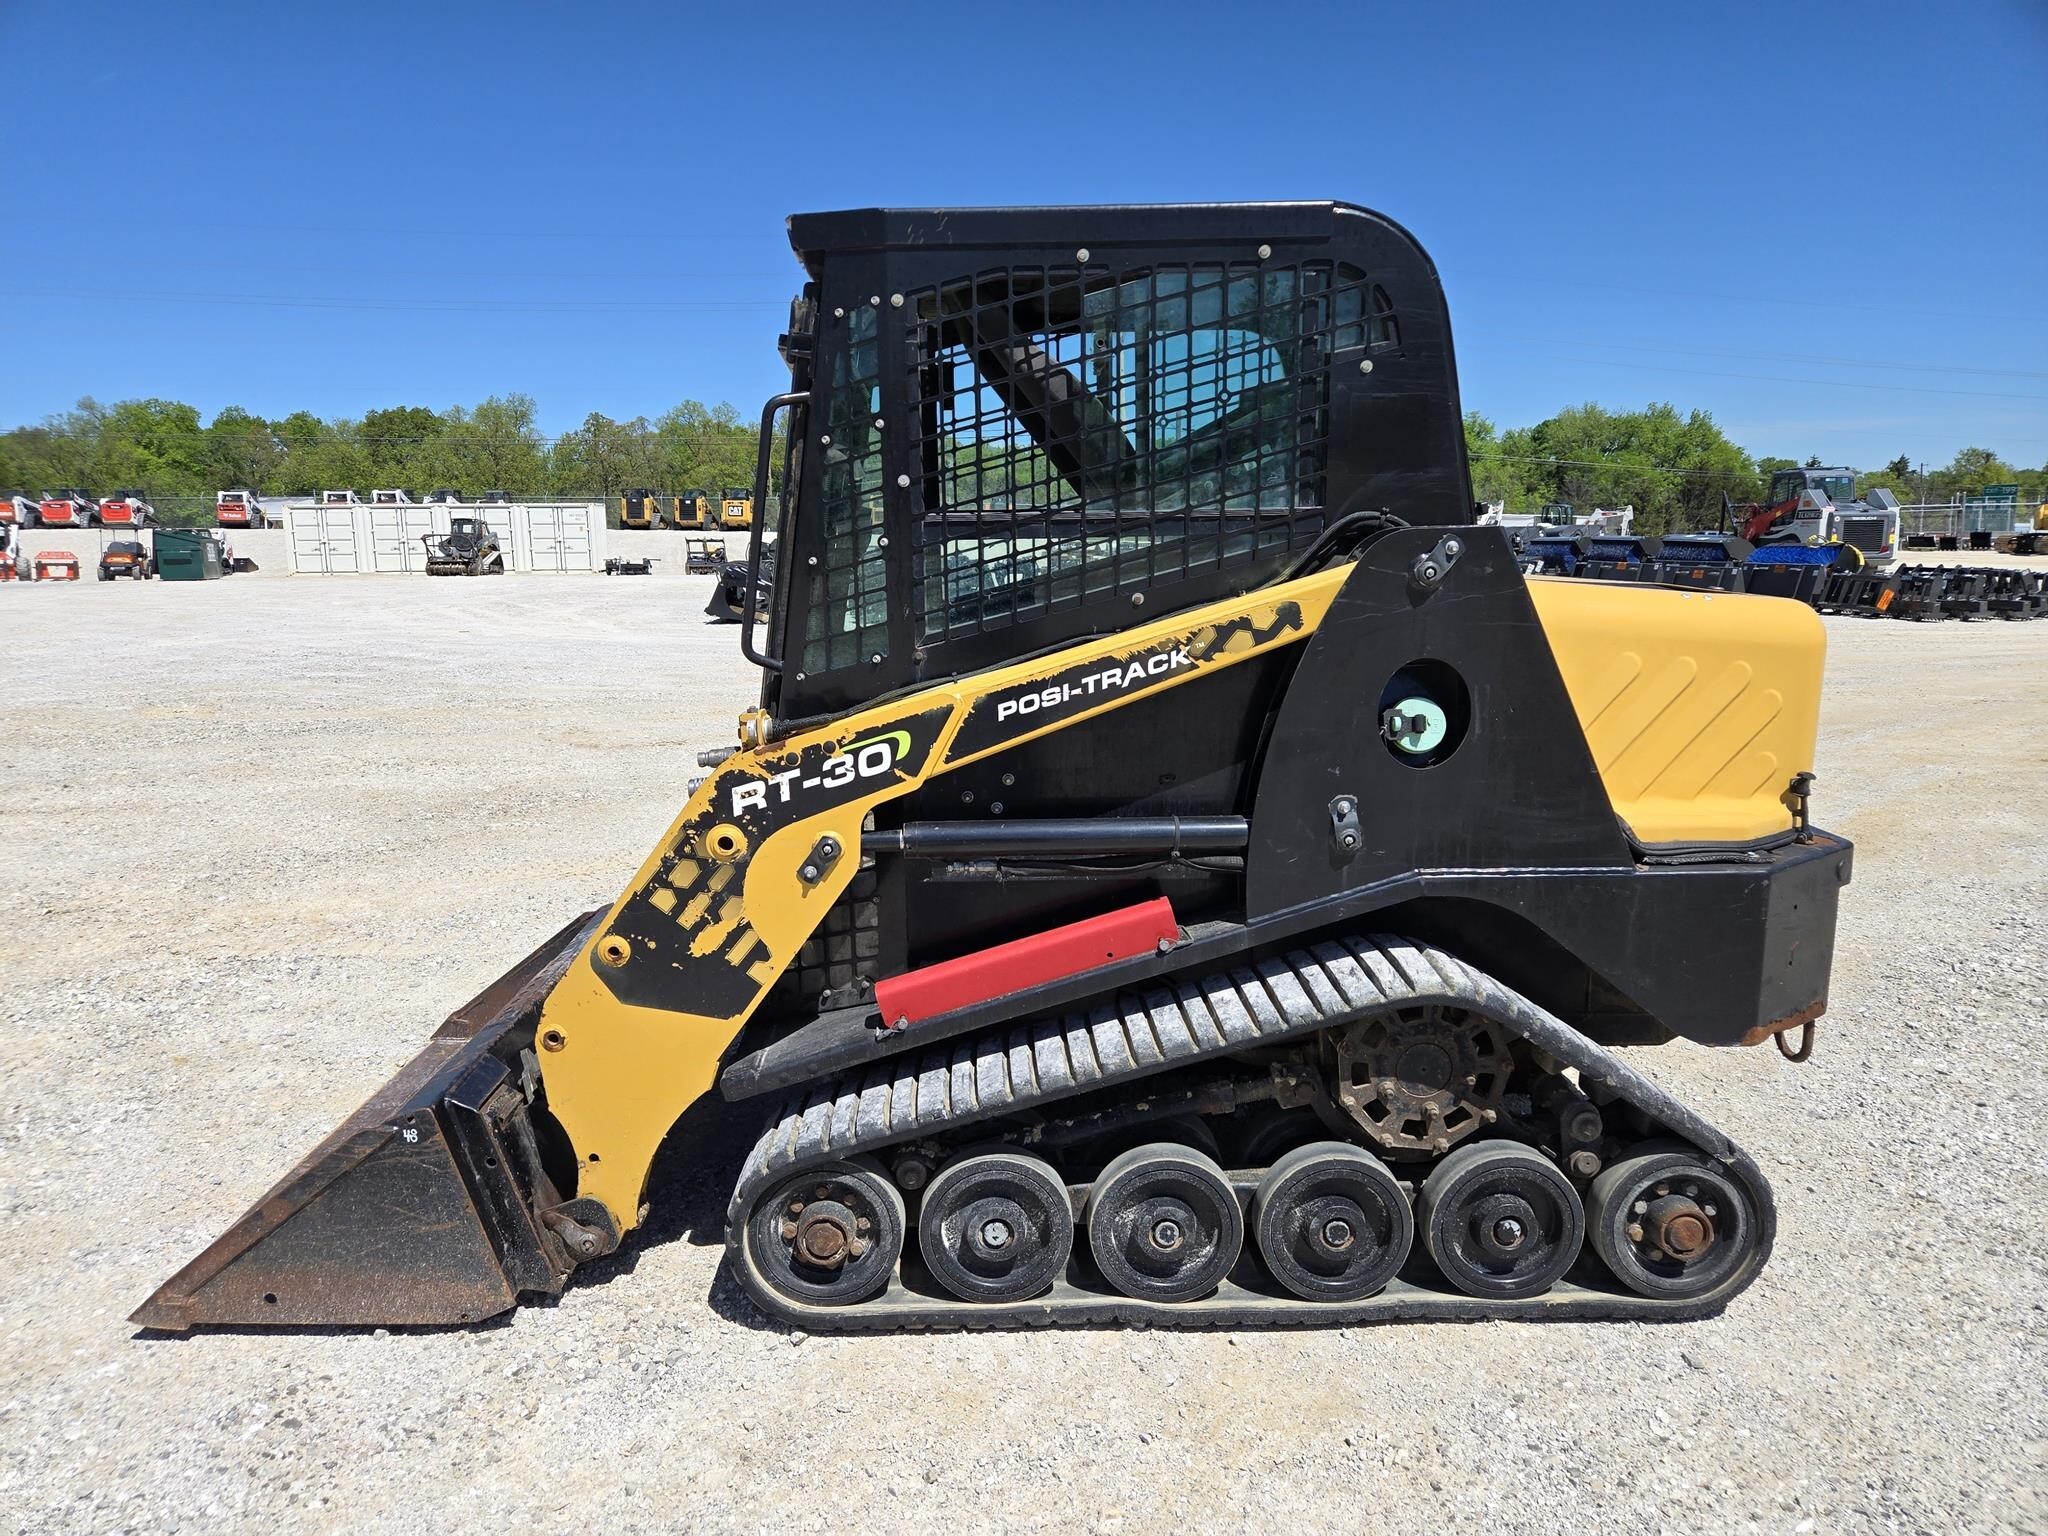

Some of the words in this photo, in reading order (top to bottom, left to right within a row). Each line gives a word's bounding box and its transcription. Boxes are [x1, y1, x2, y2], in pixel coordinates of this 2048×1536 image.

[728, 506, 743, 515] CAT
[997, 645, 1192, 722] POSI-TRACK
[731, 742, 892, 818] RT-30
[402, 1128, 418, 1143] 48
